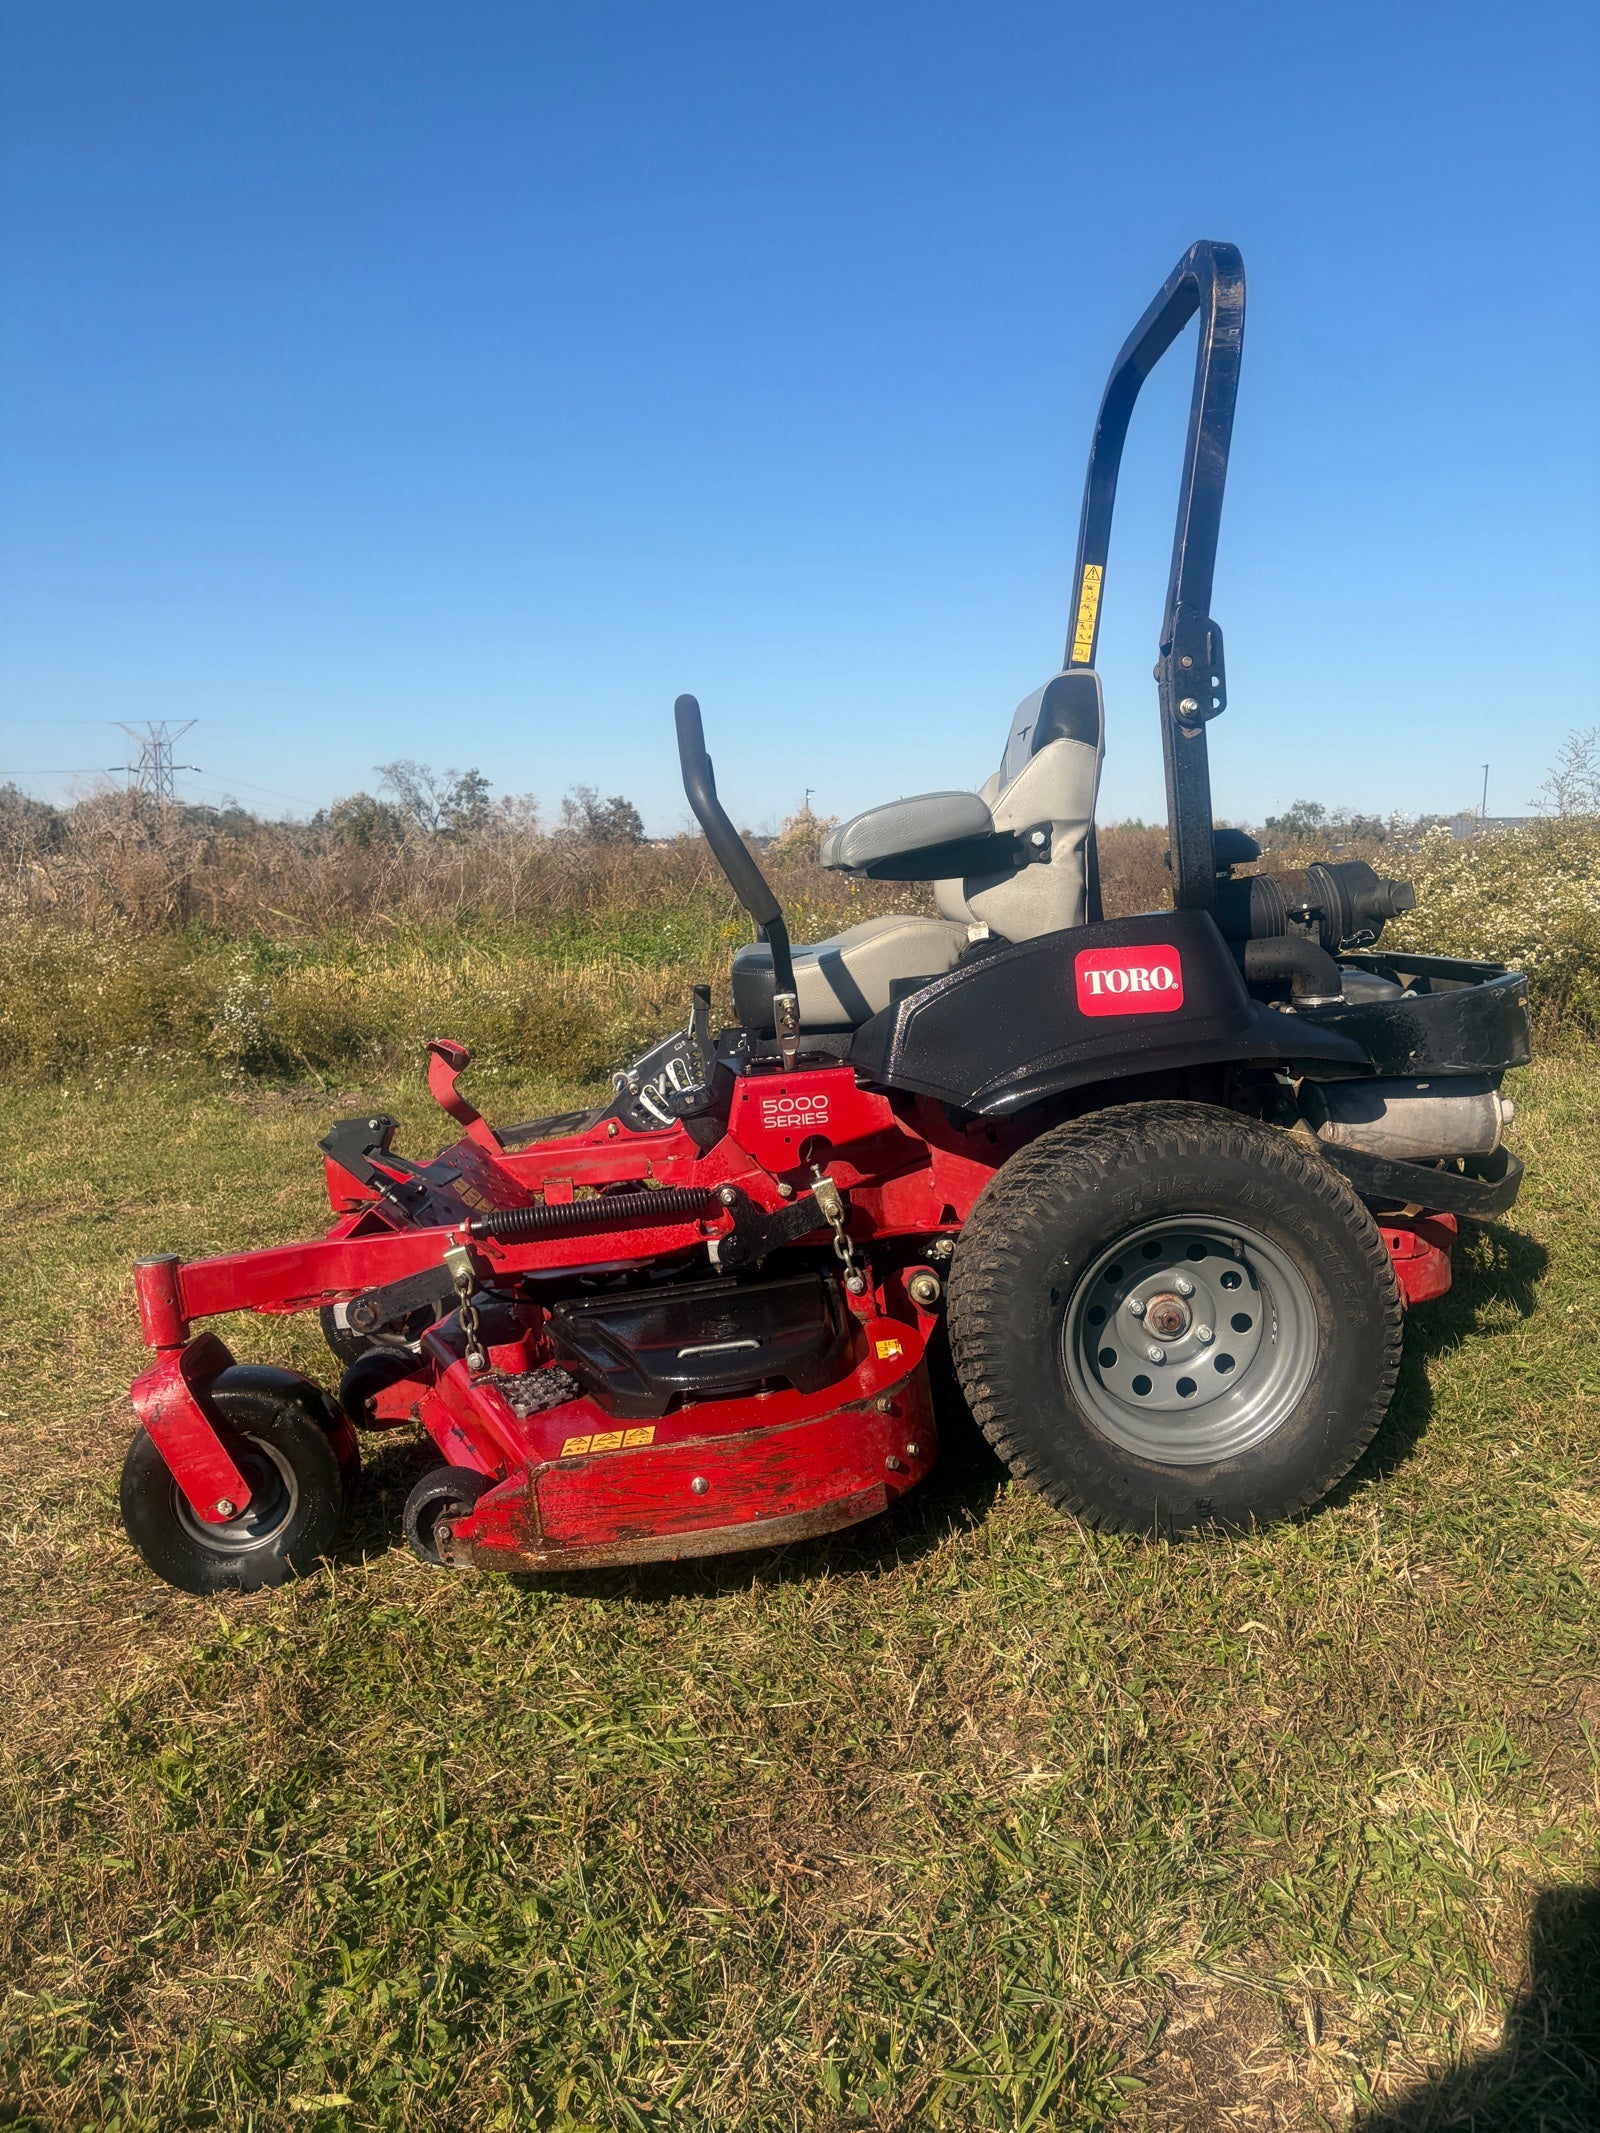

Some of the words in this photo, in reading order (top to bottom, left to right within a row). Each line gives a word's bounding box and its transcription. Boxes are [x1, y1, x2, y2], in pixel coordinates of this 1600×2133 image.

[1084, 966, 1174, 995] TORO
[762, 1095, 829, 1114] 5000
[763, 1111, 829, 1129] SERIES
[1112, 1175, 1225, 1214] TURF
[1237, 1181, 1369, 1328] MASTER
